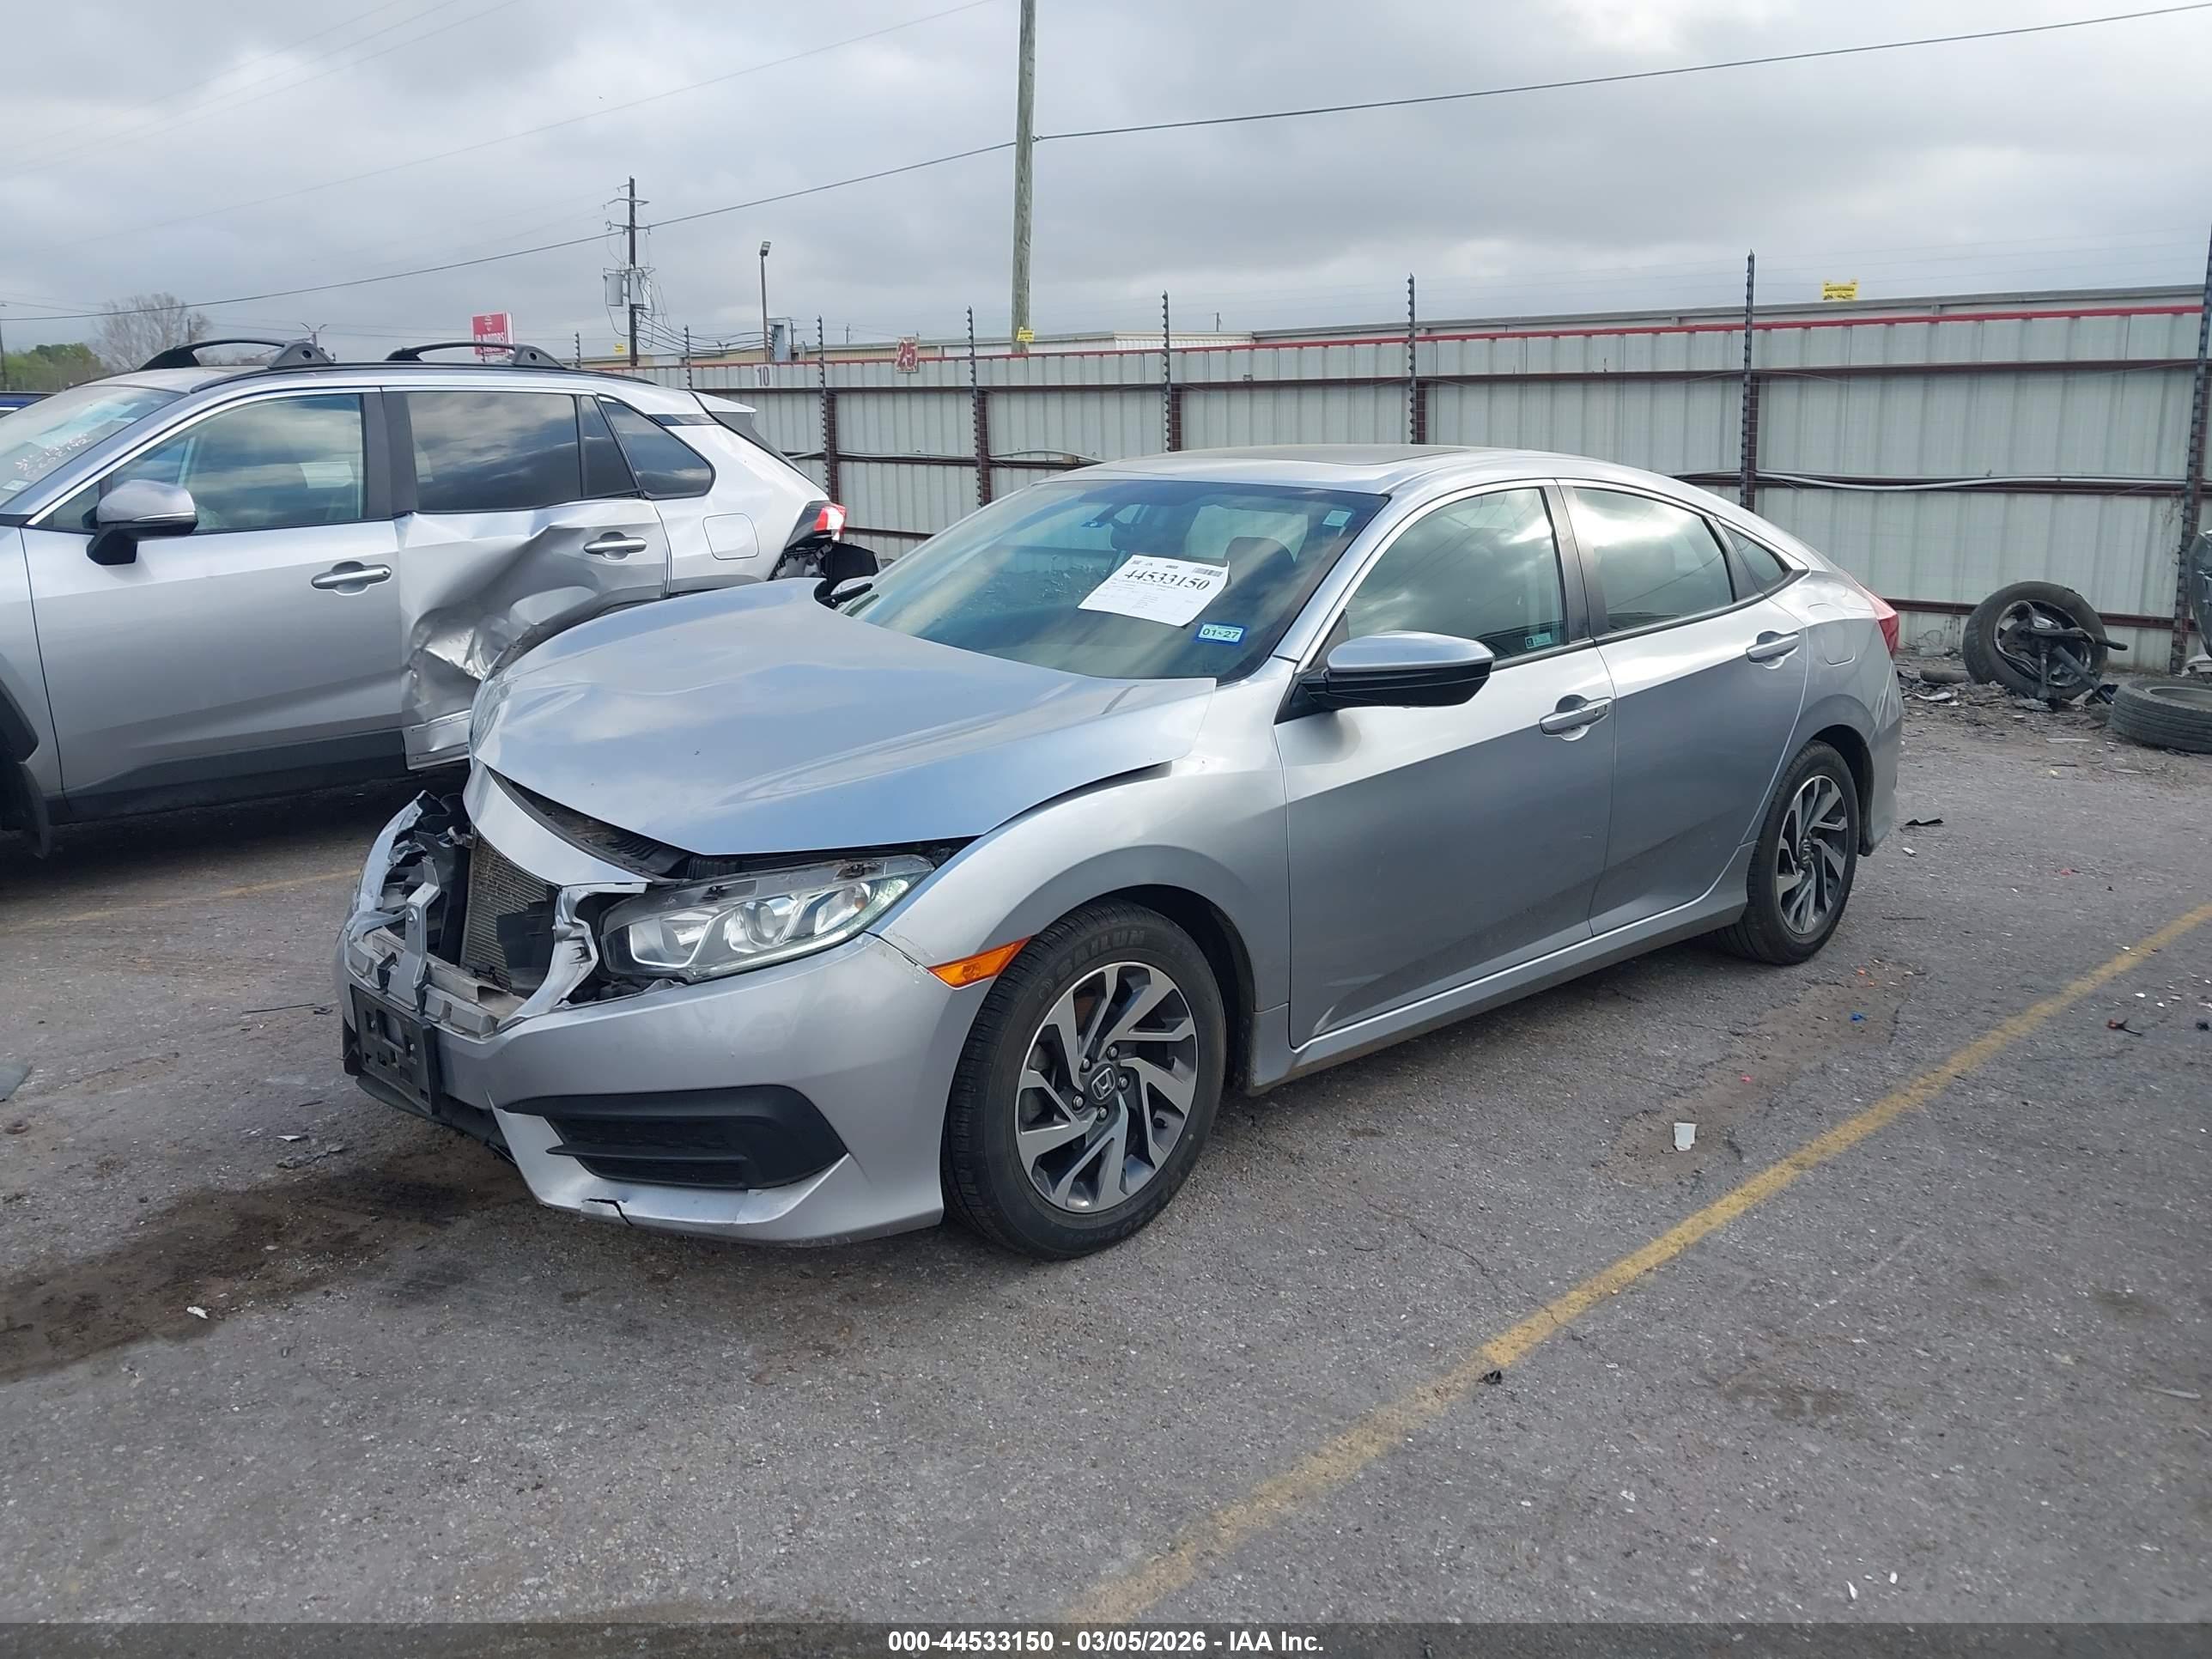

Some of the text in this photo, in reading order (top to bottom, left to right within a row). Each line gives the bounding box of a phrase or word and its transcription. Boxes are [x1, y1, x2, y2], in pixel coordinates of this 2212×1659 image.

[896, 342, 918, 367] 25
[757, 366, 770, 386] 10
[1124, 569, 1211, 591] 44533150
